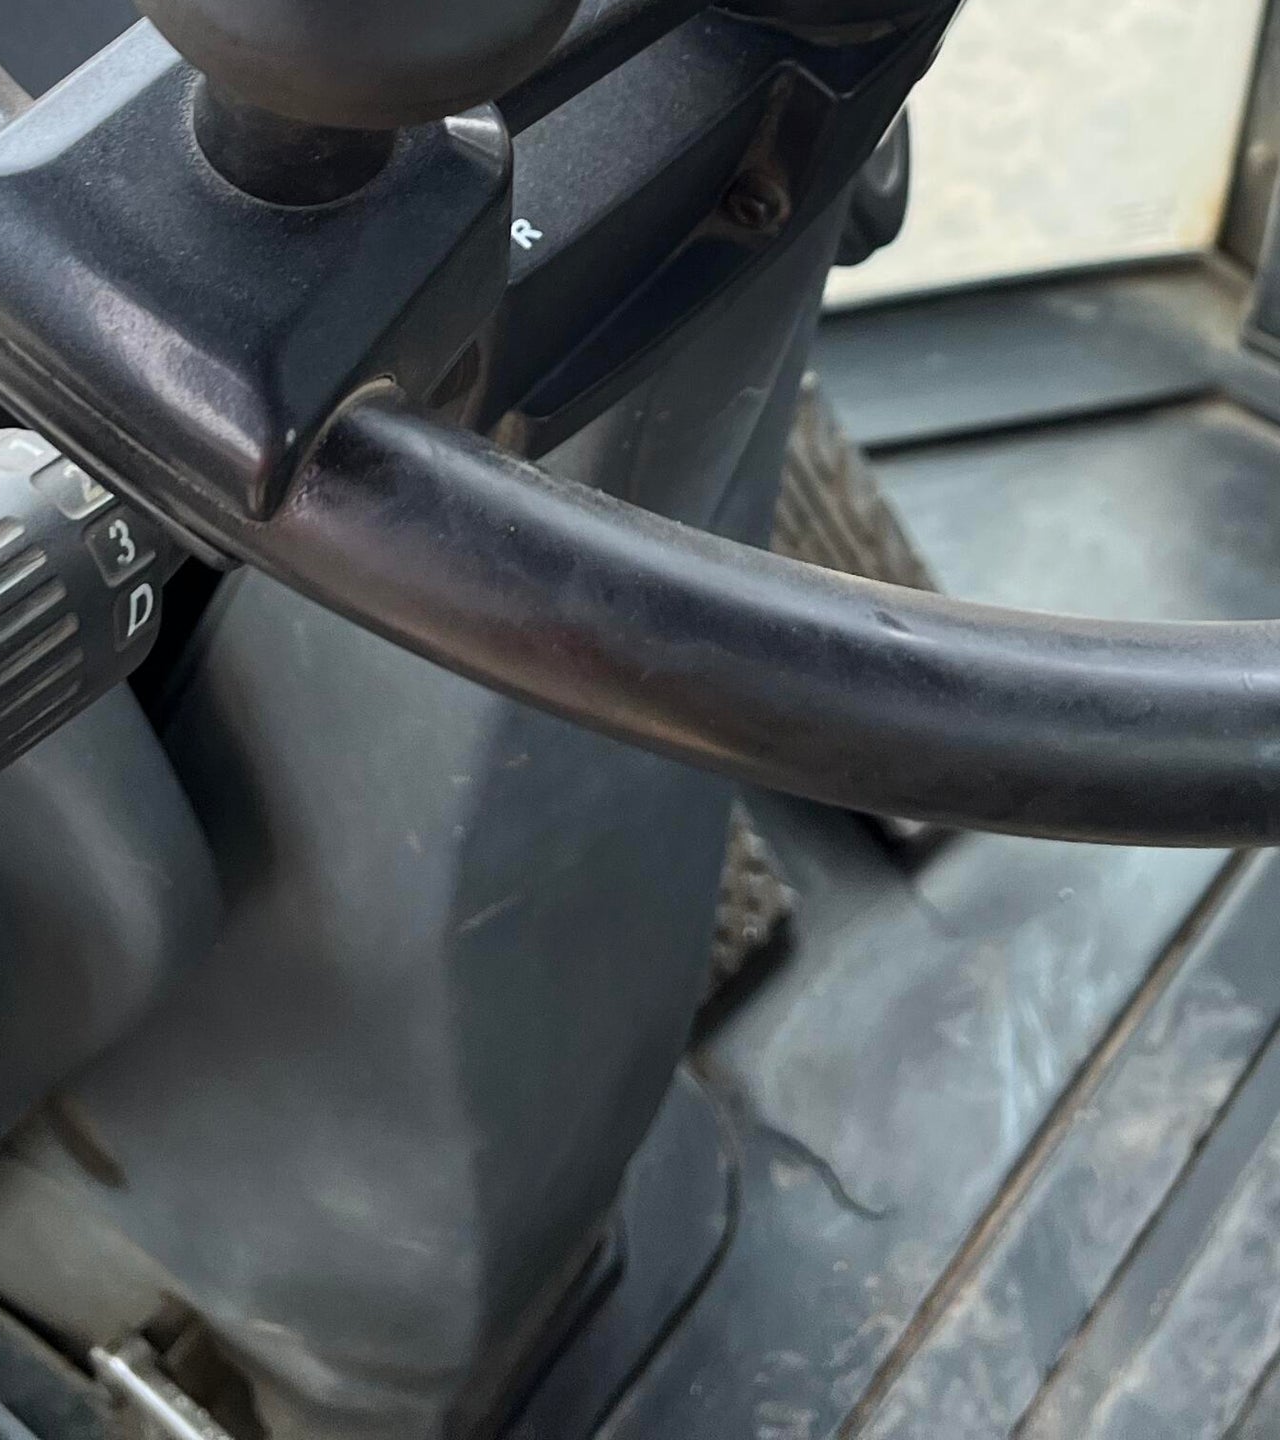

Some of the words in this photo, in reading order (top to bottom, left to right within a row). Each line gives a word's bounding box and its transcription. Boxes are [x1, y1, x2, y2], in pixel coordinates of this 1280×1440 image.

[511, 218, 543, 250] R
[64, 463, 108, 503] 2
[109, 518, 136, 565] 3
[127, 582, 154, 638] D
